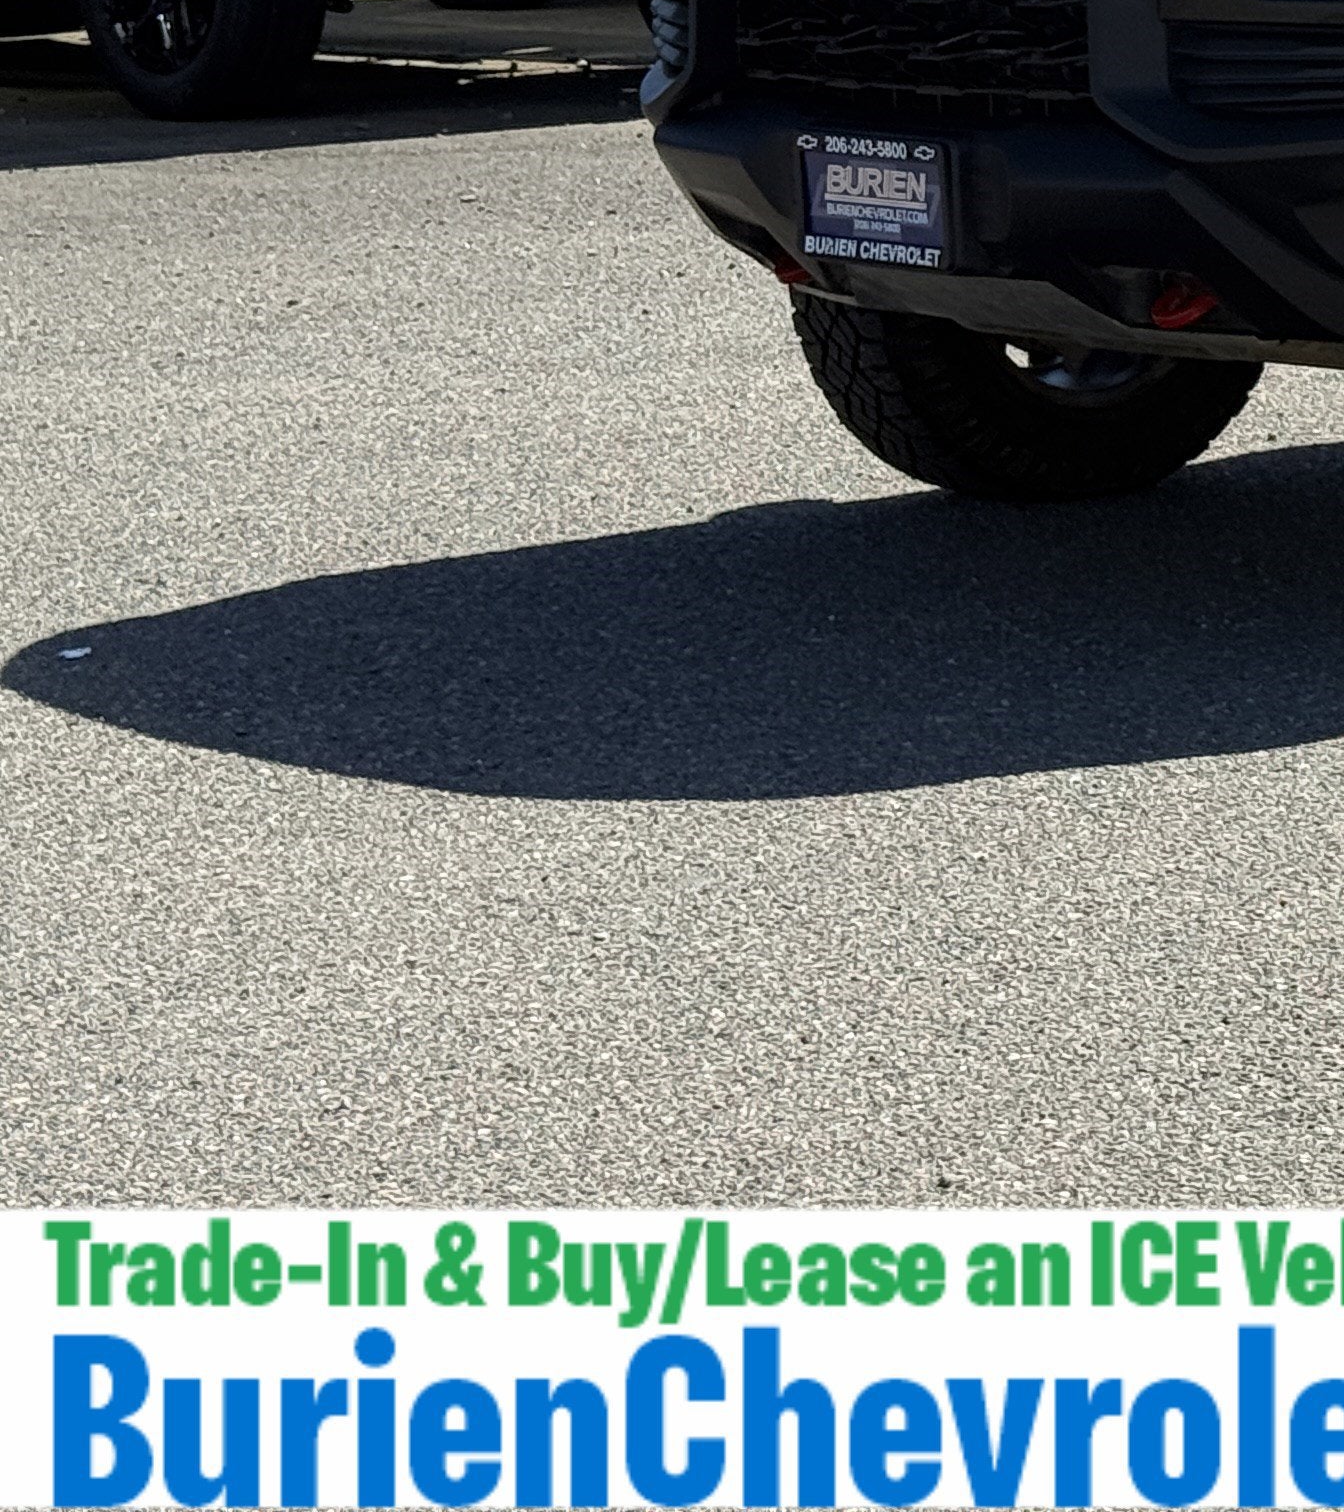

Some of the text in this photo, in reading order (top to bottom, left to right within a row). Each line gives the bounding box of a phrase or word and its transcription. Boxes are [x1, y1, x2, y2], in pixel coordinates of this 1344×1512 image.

[825, 136, 907, 160] 206-243-5800
[827, 164, 926, 201] BURIEN
[805, 236, 941, 267] BURIEN CHEVROLET
